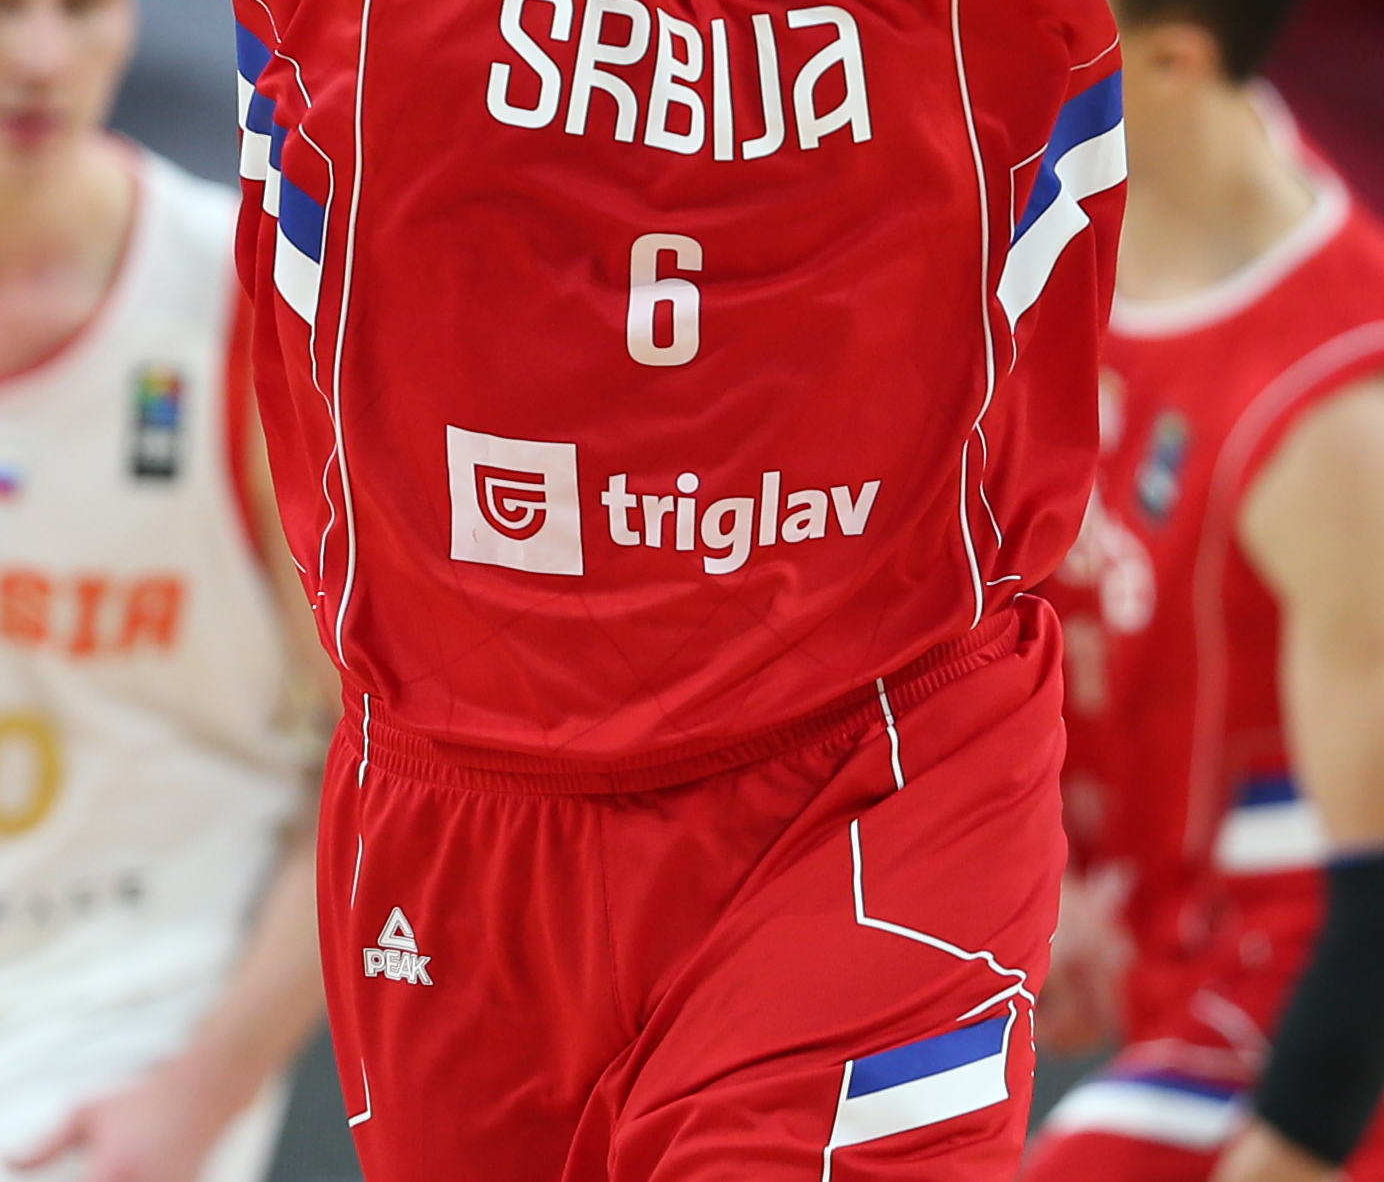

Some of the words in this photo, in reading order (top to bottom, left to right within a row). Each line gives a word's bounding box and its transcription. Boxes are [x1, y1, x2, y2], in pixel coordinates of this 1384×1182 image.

[626, 233, 703, 366] 6
[600, 470, 881, 574] triglav
[362, 947, 434, 986] PEAK
